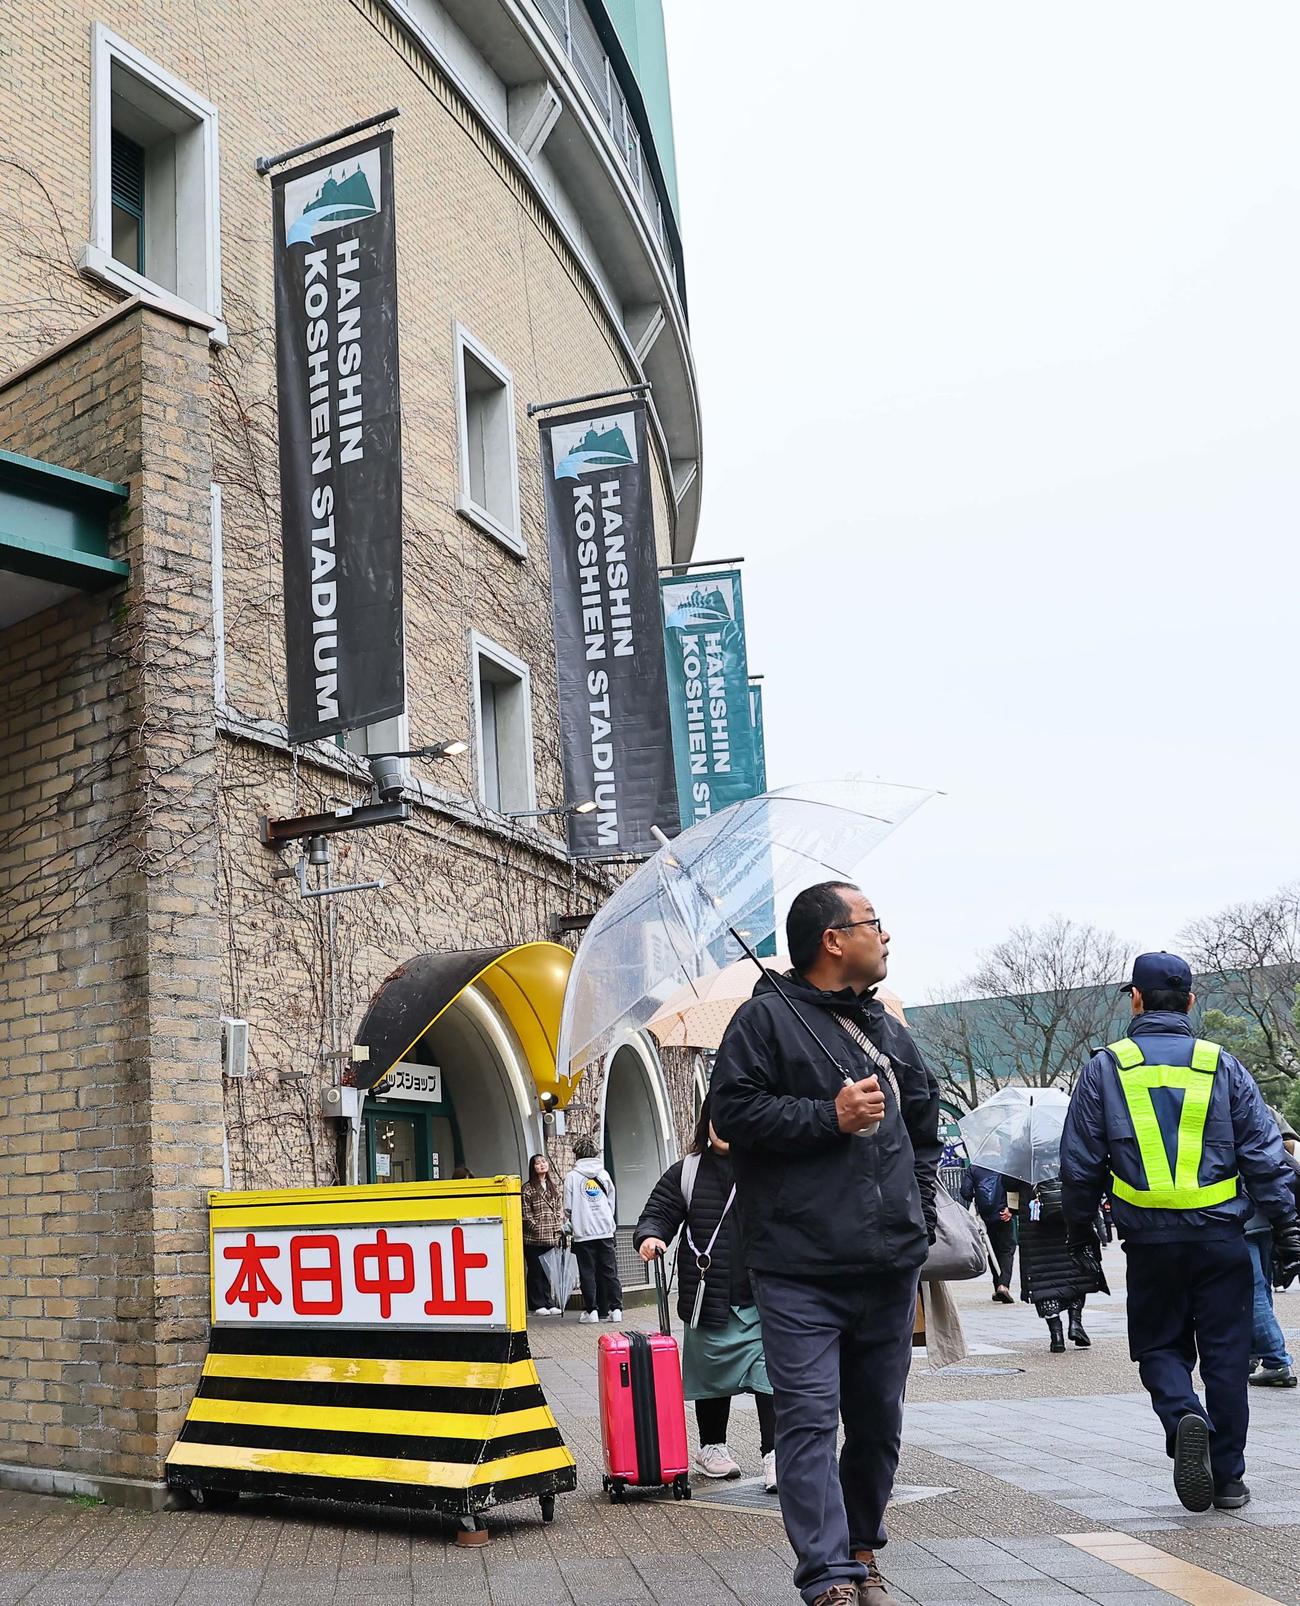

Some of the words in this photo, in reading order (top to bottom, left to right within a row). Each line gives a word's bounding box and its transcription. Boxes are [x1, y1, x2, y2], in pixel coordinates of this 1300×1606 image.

[304, 251, 332, 475] KOSHIEN
[336, 238, 364, 464] HANSHIN
[311, 484, 339, 723] STADIUM
[572, 484, 606, 661] KOSHIEN
[599, 480, 635, 658] HANSHIN
[587, 669, 620, 847] STADIUM
[682, 634, 708, 775] KOSHIEN
[704, 632, 731, 773] HANSHIN
[223, 1226, 493, 1319] 本日中止
